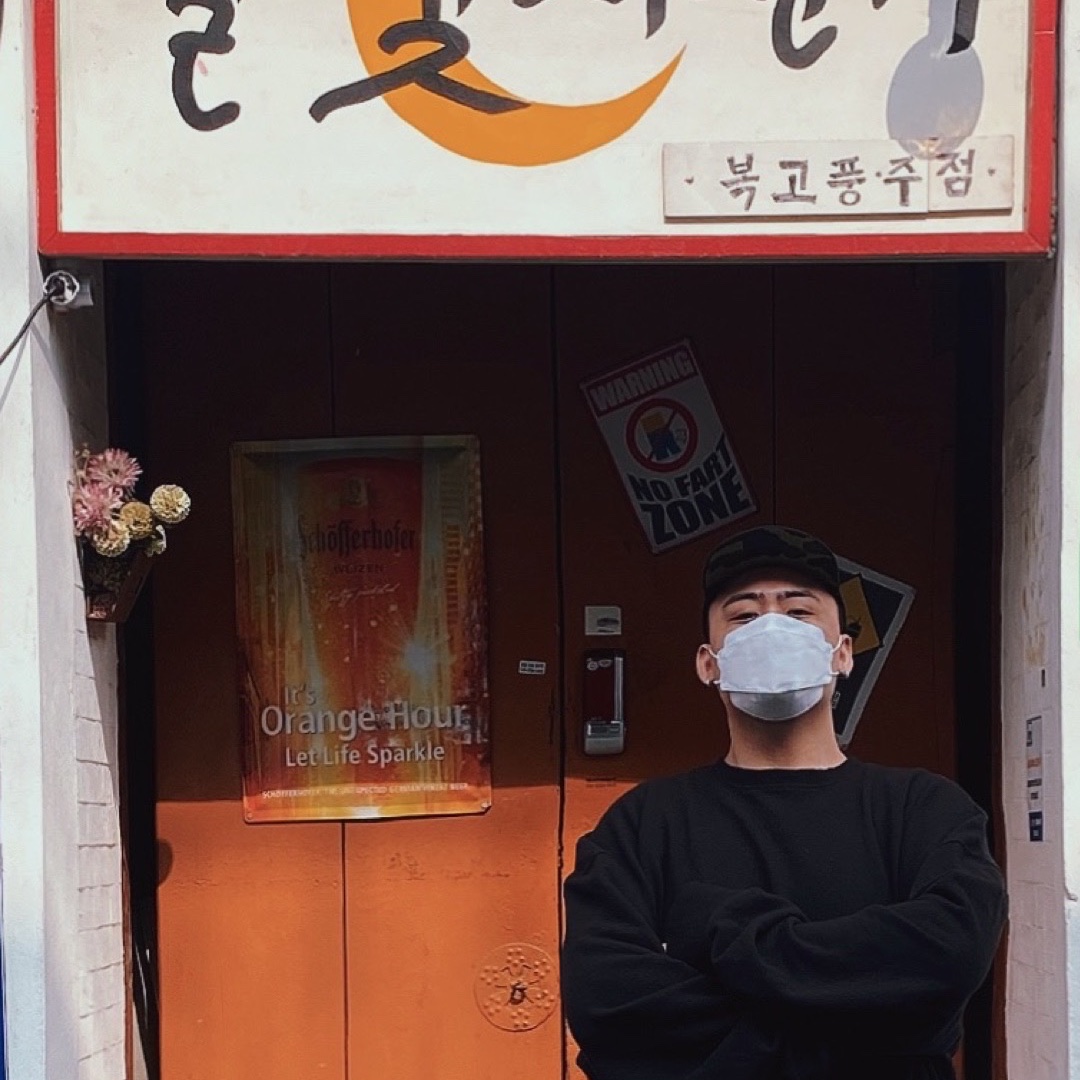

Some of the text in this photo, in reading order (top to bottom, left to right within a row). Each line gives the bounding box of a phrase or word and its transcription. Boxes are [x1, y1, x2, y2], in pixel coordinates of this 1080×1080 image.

[588, 348, 697, 412] WARNING
[626, 432, 732, 502] NO FART
[639, 467, 751, 545] ZONE
[284, 685, 317, 706] It's
[261, 705, 378, 742] Orange
[285, 740, 446, 769] Let Life Sparkle
